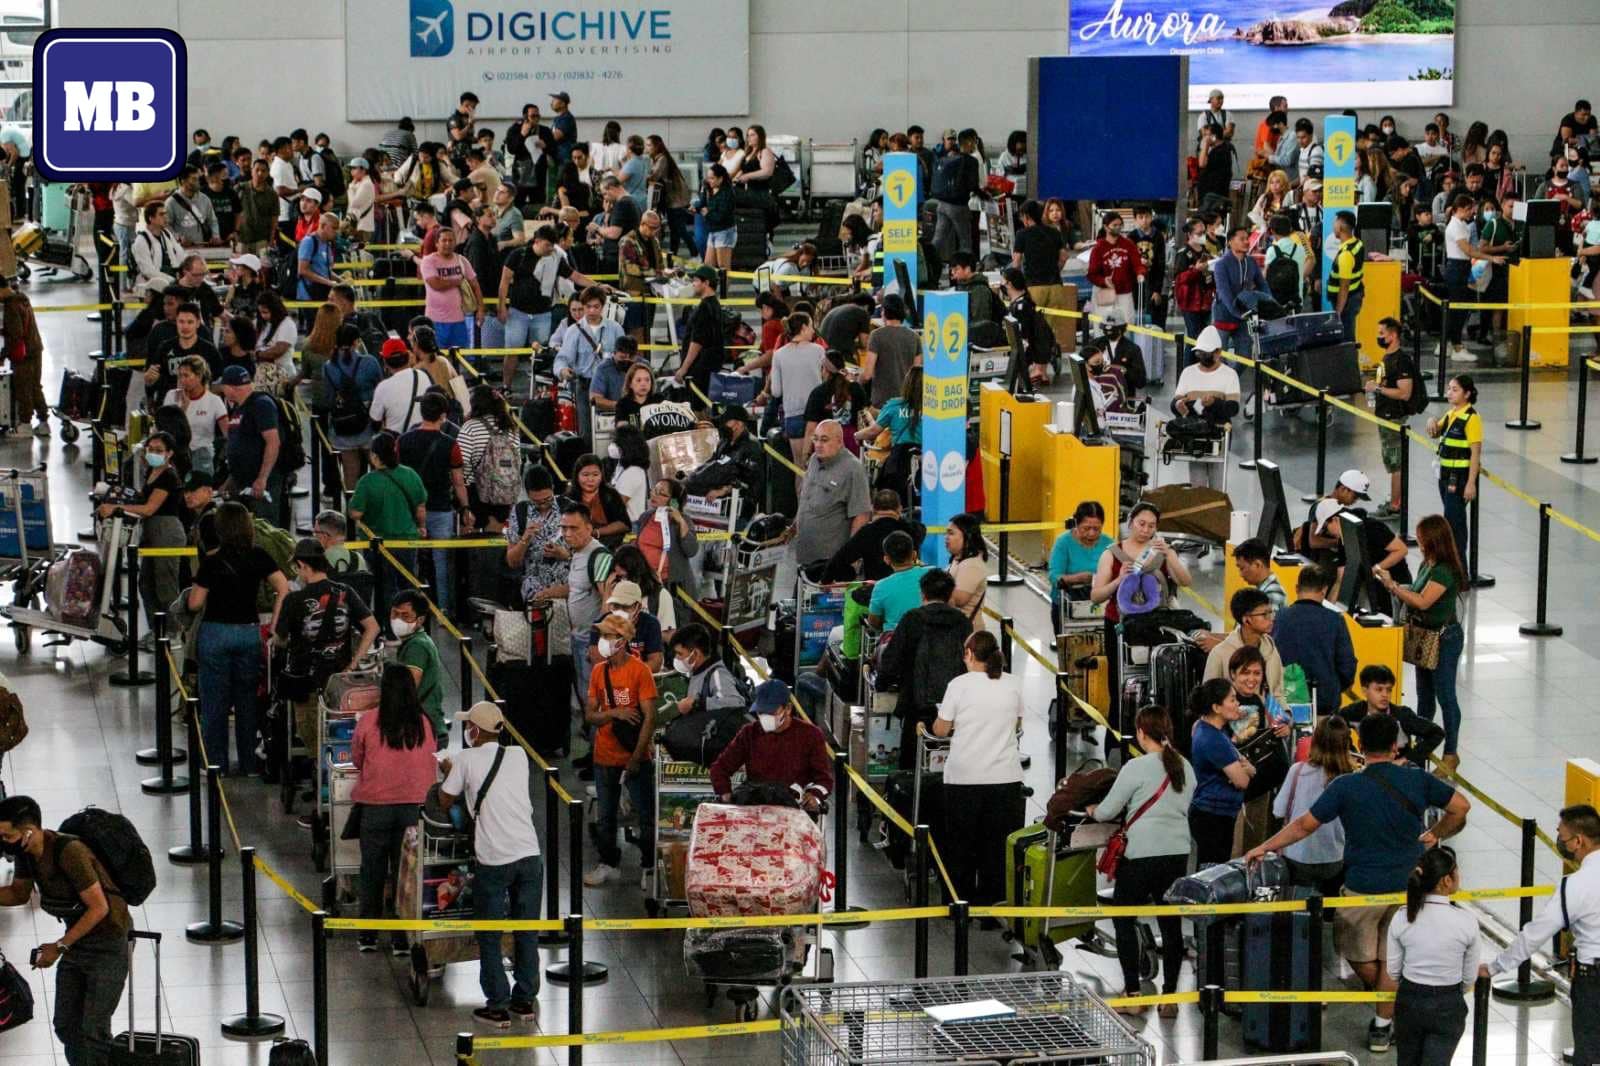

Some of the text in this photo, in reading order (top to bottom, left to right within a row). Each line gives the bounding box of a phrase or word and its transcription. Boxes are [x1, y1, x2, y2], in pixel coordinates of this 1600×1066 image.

[467, 10, 671, 41] DIGICHIVE
[1079, 0, 1226, 46] Aurora
[467, 45, 672, 56] AIRPORT ADVERTISING
[1334, 143, 1344, 161] 1
[892, 183, 903, 202] 1
[1327, 184, 1351, 194] SELF
[887, 228, 913, 238] SELF
[927, 329, 936, 353] 2
[948, 328, 960, 354] 2
[943, 383, 963, 397] BAG
[941, 396, 966, 411] DROP
[665, 764, 696, 775] WEST
